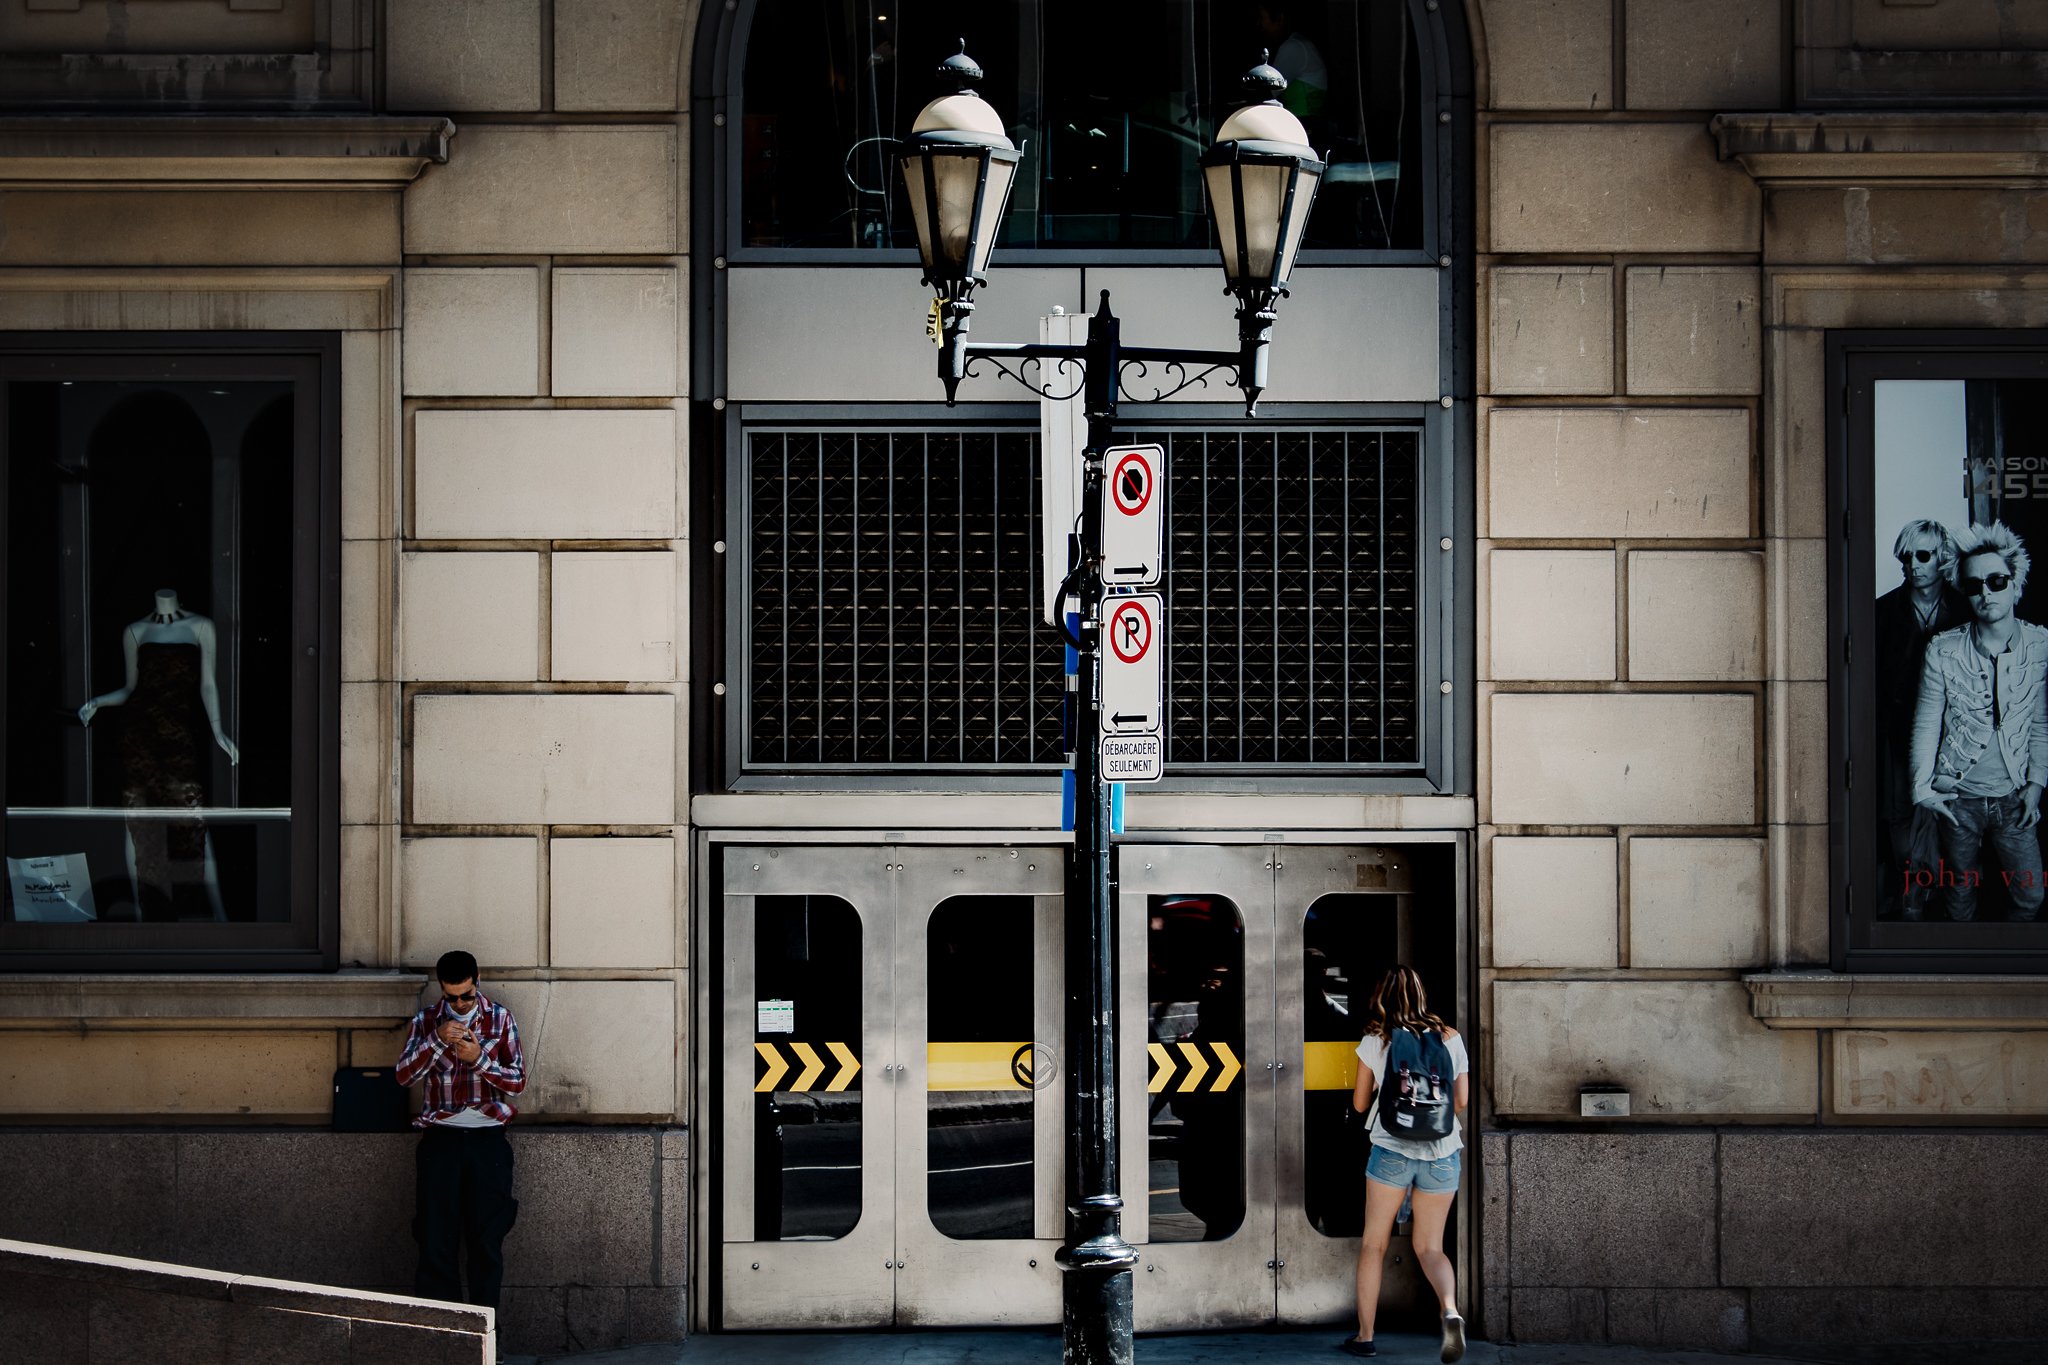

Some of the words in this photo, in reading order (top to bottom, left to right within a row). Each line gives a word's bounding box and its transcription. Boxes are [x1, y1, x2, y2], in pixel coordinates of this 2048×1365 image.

[1963, 473, 2048, 499] 1455
[1125, 616, 1140, 649] P
[1105, 740, 1157, 755] DÉBARCADÈRE
[1109, 759, 1153, 773] SEULEMENT
[1903, 857, 1980, 896] john
